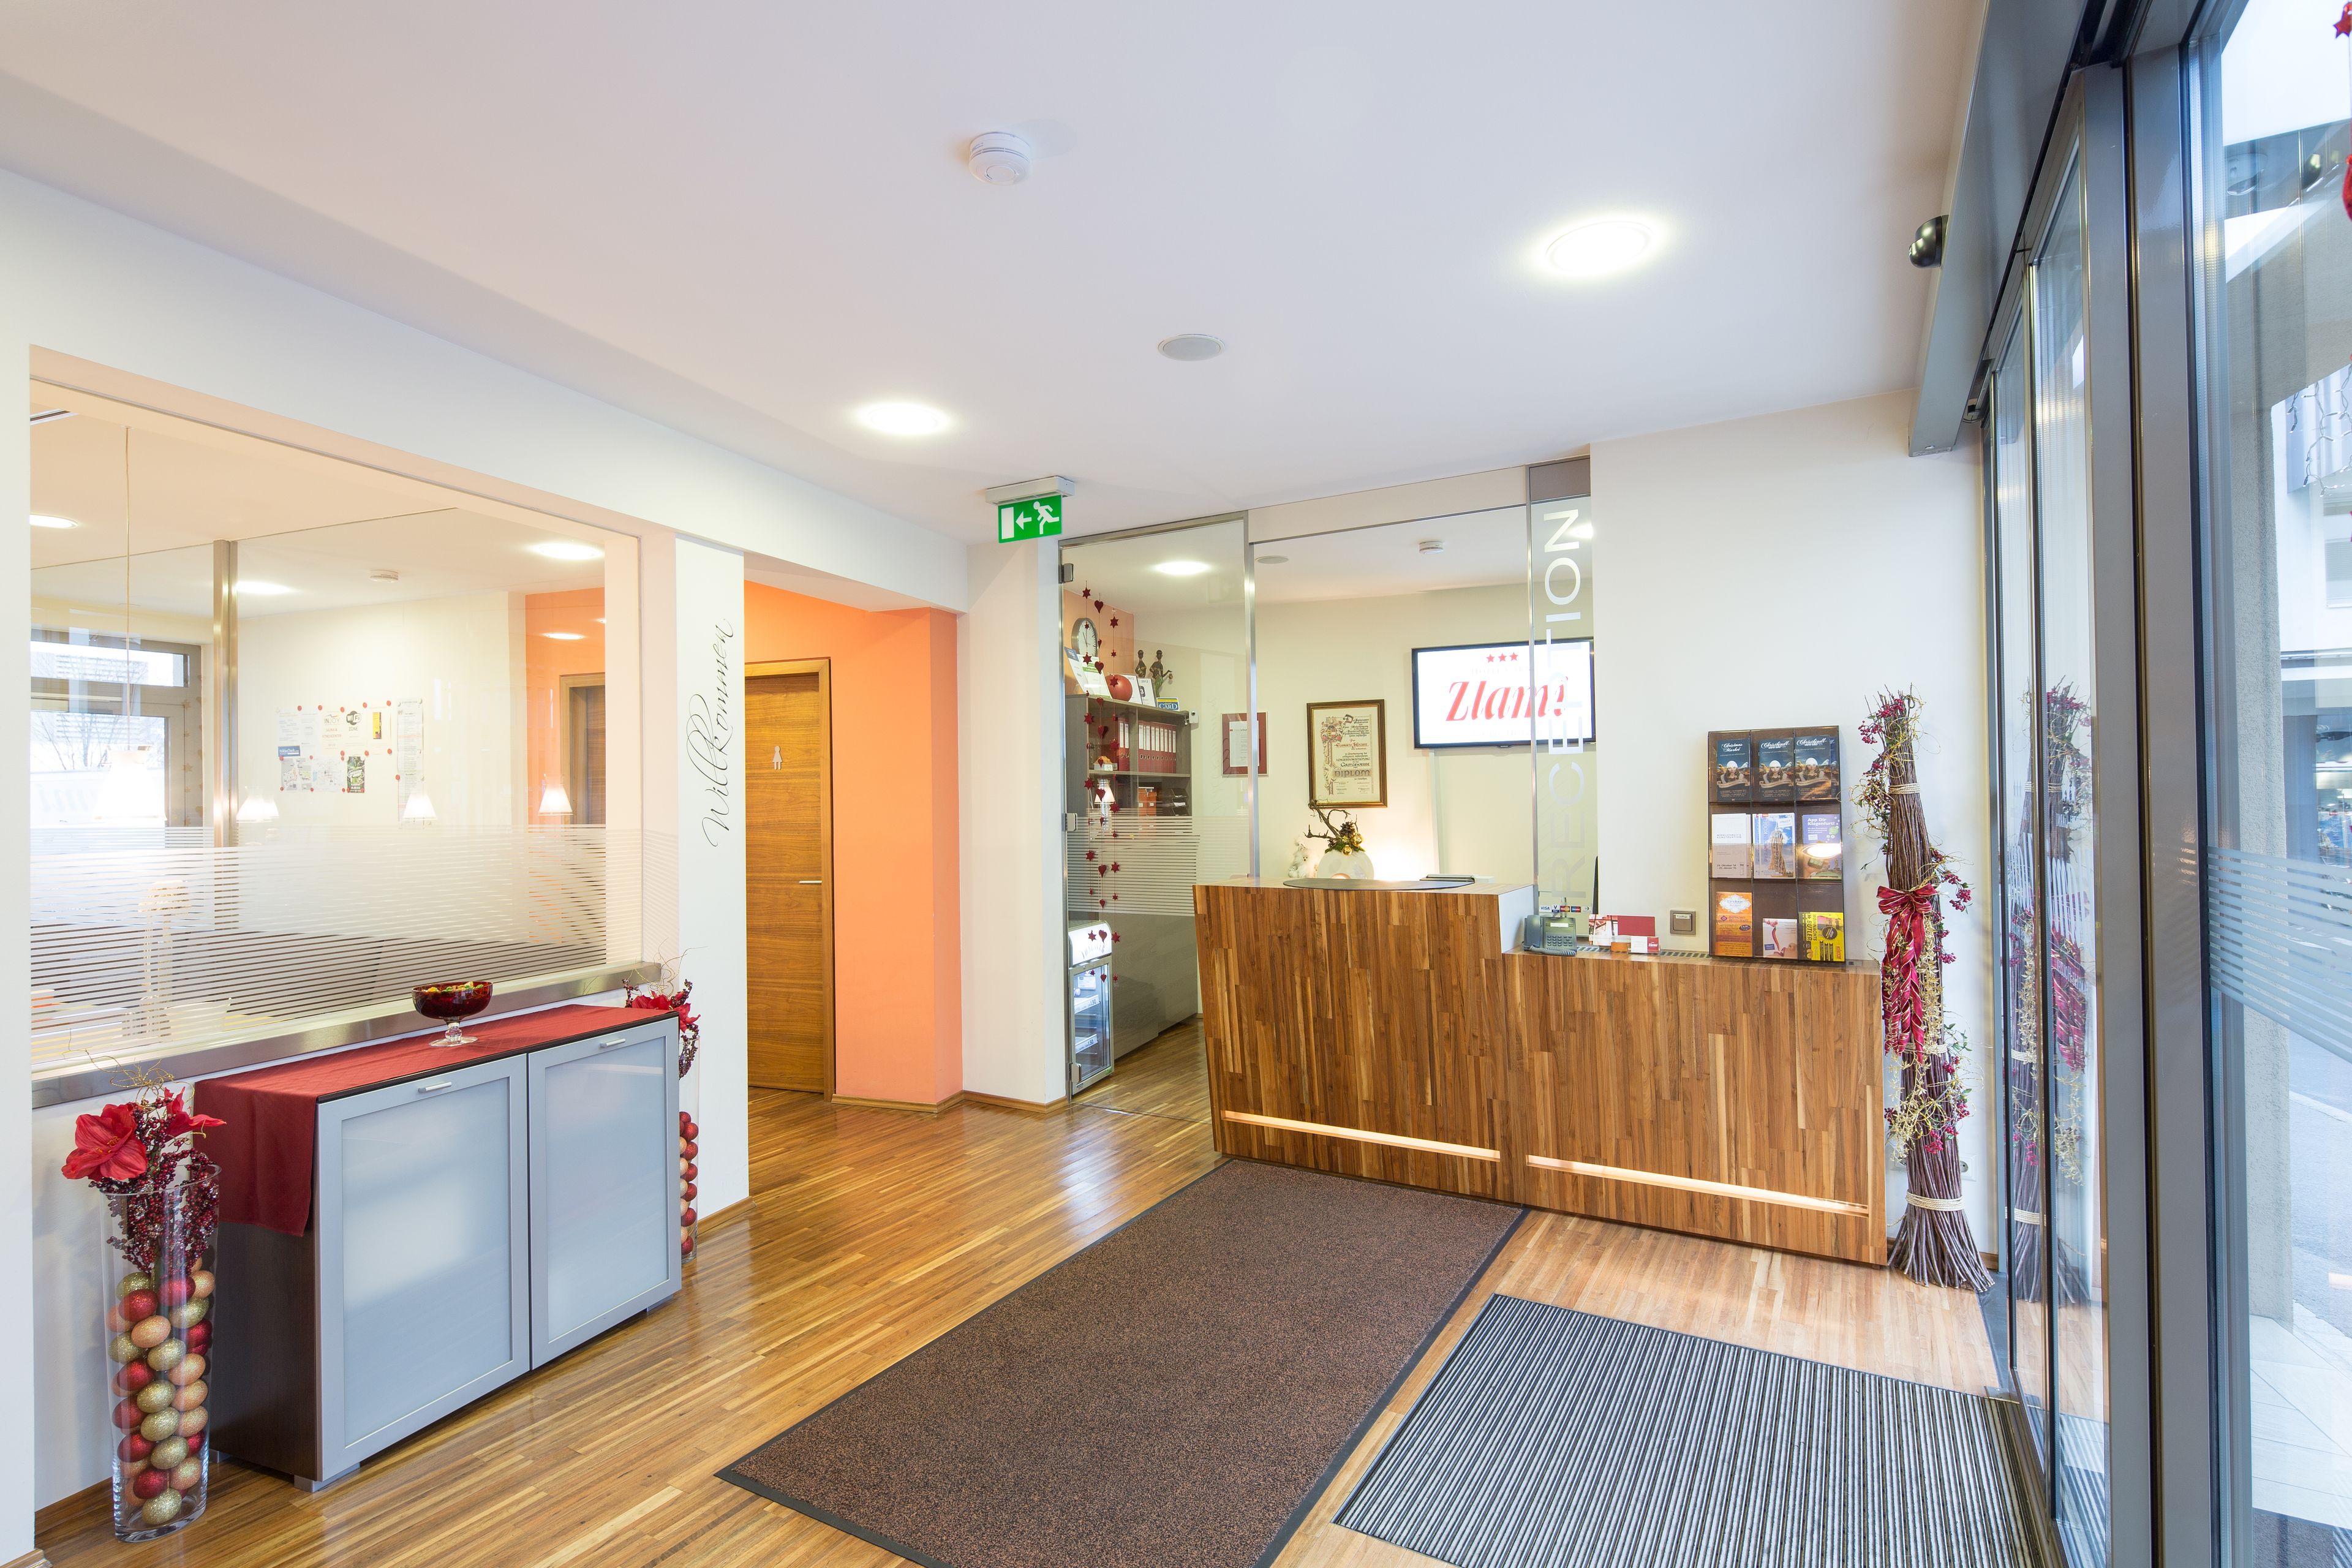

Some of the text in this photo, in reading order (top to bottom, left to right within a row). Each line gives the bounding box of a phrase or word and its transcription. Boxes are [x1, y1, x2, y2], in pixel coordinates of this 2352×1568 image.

[686, 618, 734, 848] Willkommen
[1446, 676, 1569, 722] Zlami
[1543, 509, 1586, 899] RECEPTION
[1335, 769, 1371, 778] DIPLOM
